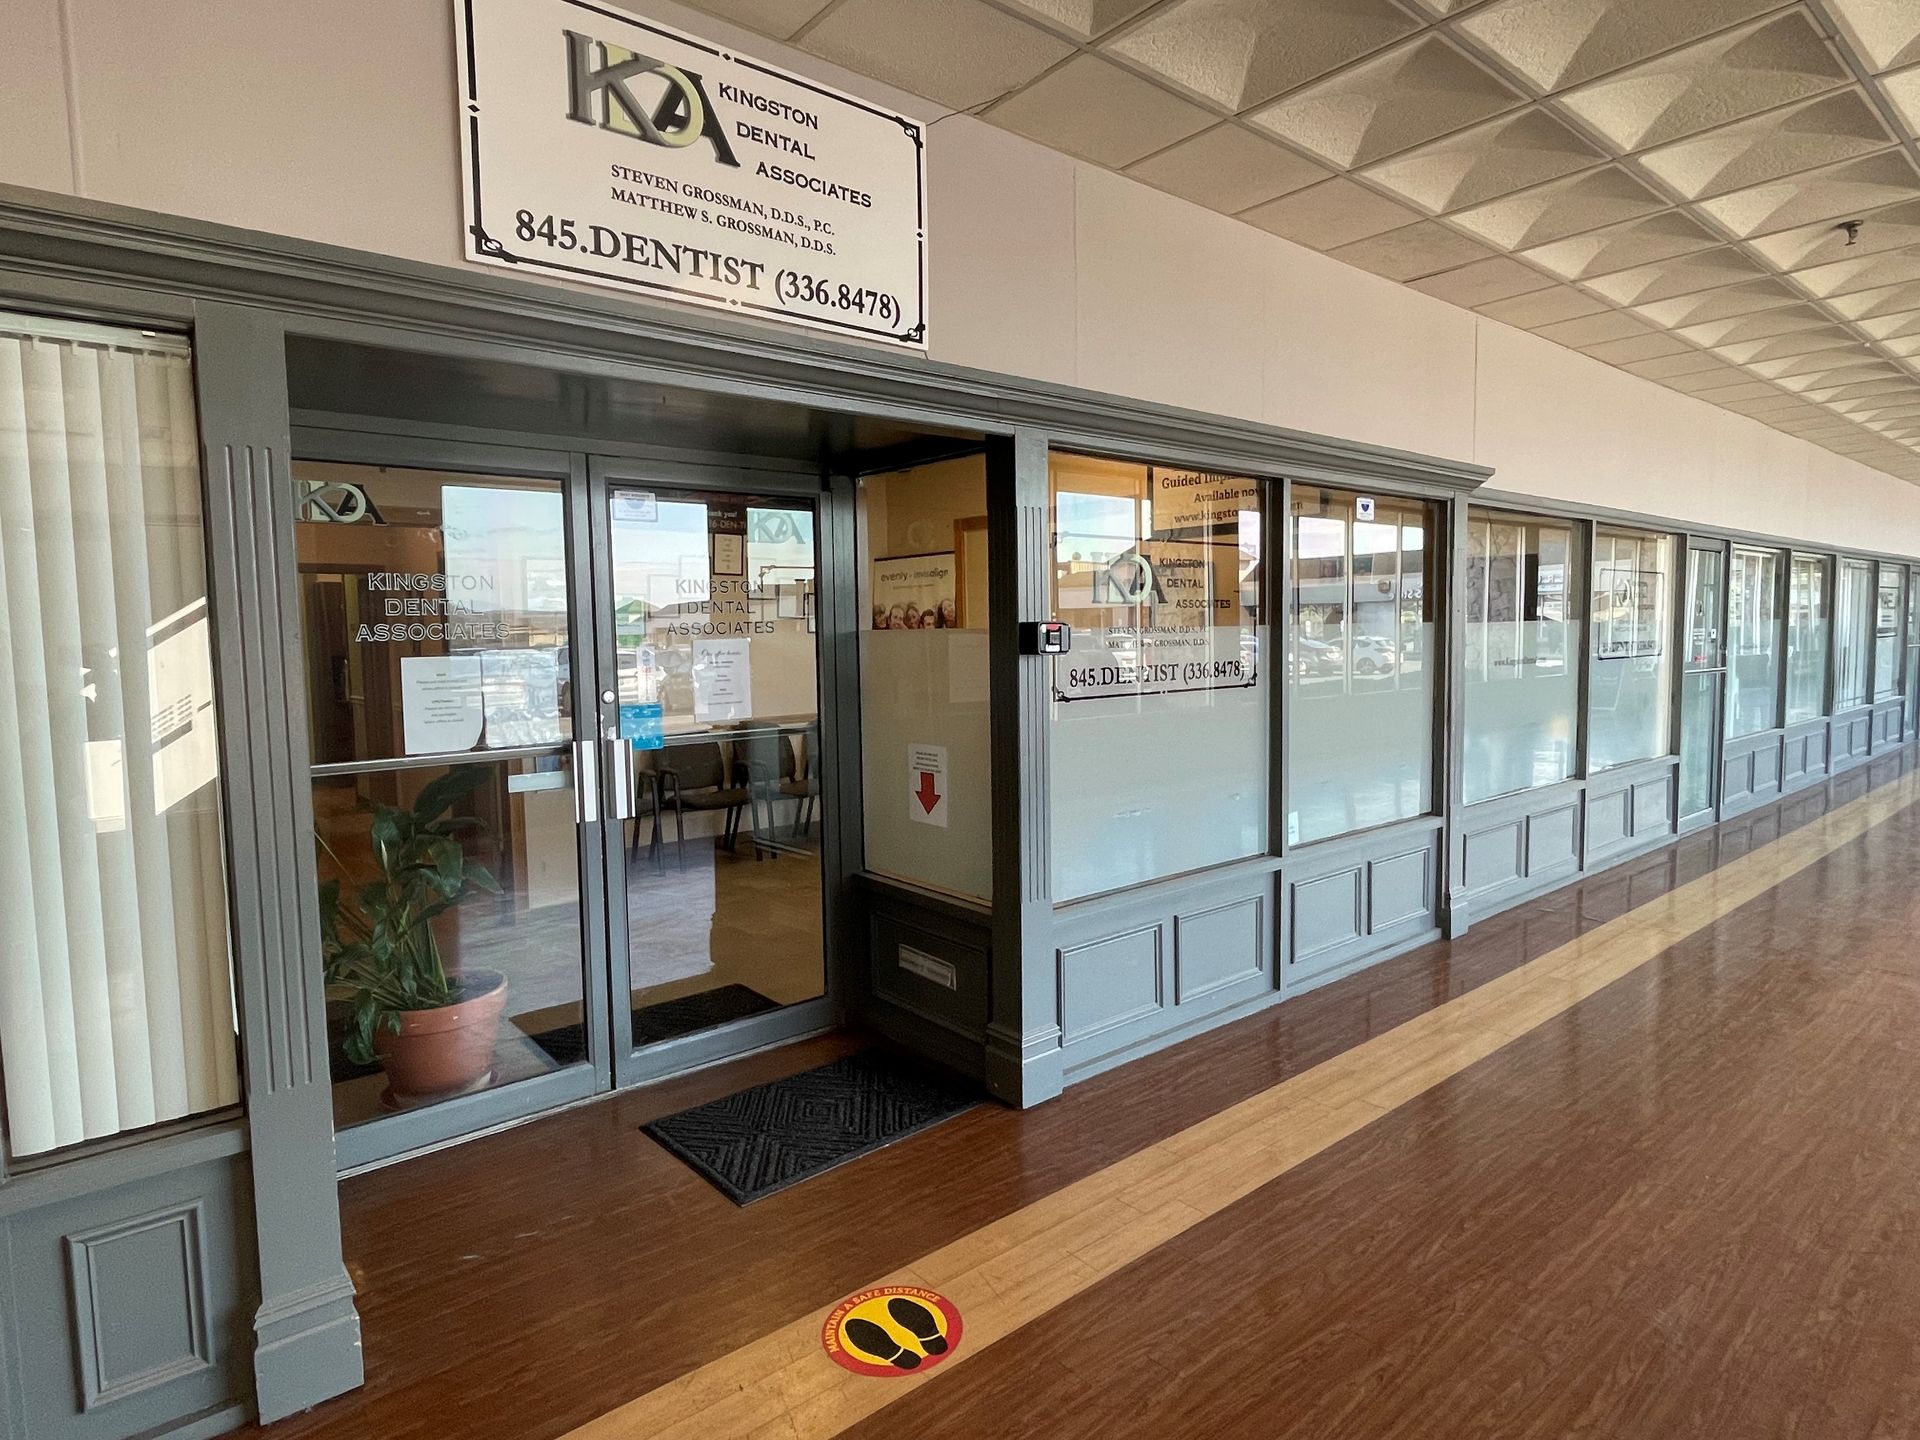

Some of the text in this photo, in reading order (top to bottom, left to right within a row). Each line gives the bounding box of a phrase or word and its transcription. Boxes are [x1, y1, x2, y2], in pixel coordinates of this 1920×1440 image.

[718, 82, 819, 130] KINGSTON
[736, 120, 816, 161] DENTAL
[755, 161, 872, 209] ASSOCIATES
[611, 164, 835, 236] STEVEN GROSSMAN, D.D.S., P.C.
[611, 187, 836, 255] MATTHEW S. GROSSMAN, D.D.S.
[515, 209, 901, 327] 845.DENTIST (336.8478)
[1162, 474, 1201, 489] Guided
[1194, 489, 1239, 503] Available
[1159, 557, 1205, 569] KINGSTON
[368, 572, 494, 591] KINGSTON
[675, 579, 764, 594] KINGSTON
[1167, 578, 1204, 589] DENTAL
[384, 598, 484, 617] DENTAL
[687, 601, 757, 615] DENTAL
[355, 623, 511, 642] ASSOCIATES
[667, 621, 775, 636] ASSOCIATES
[1108, 627, 1137, 635] STEVEN
[1070, 661, 1245, 688] 845.DENTIST (336.8478)
[825, 1309, 845, 1352] MAINTAIN
[852, 1288, 882, 1304] SAFE
[884, 1287, 941, 1303] DISTANCE
